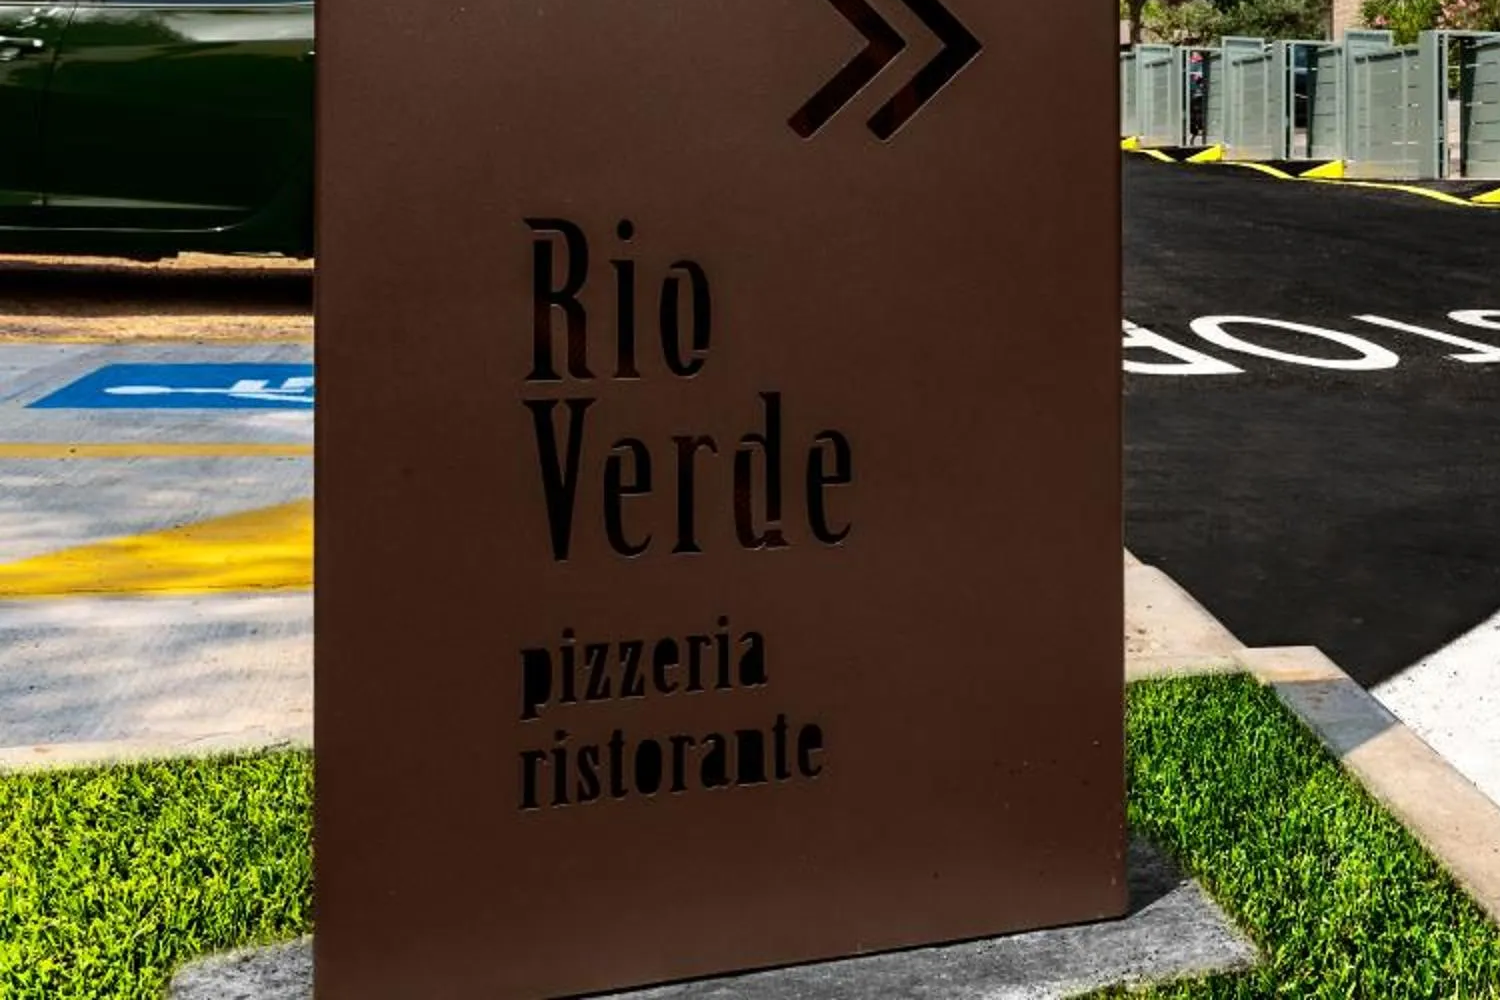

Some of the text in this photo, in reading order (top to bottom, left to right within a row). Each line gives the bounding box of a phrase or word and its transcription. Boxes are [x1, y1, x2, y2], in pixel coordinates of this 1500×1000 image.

[523, 217, 712, 381] Rio
[522, 391, 852, 562] Verde
[519, 614, 768, 722] pizzeria
[518, 713, 824, 812] ristorante
